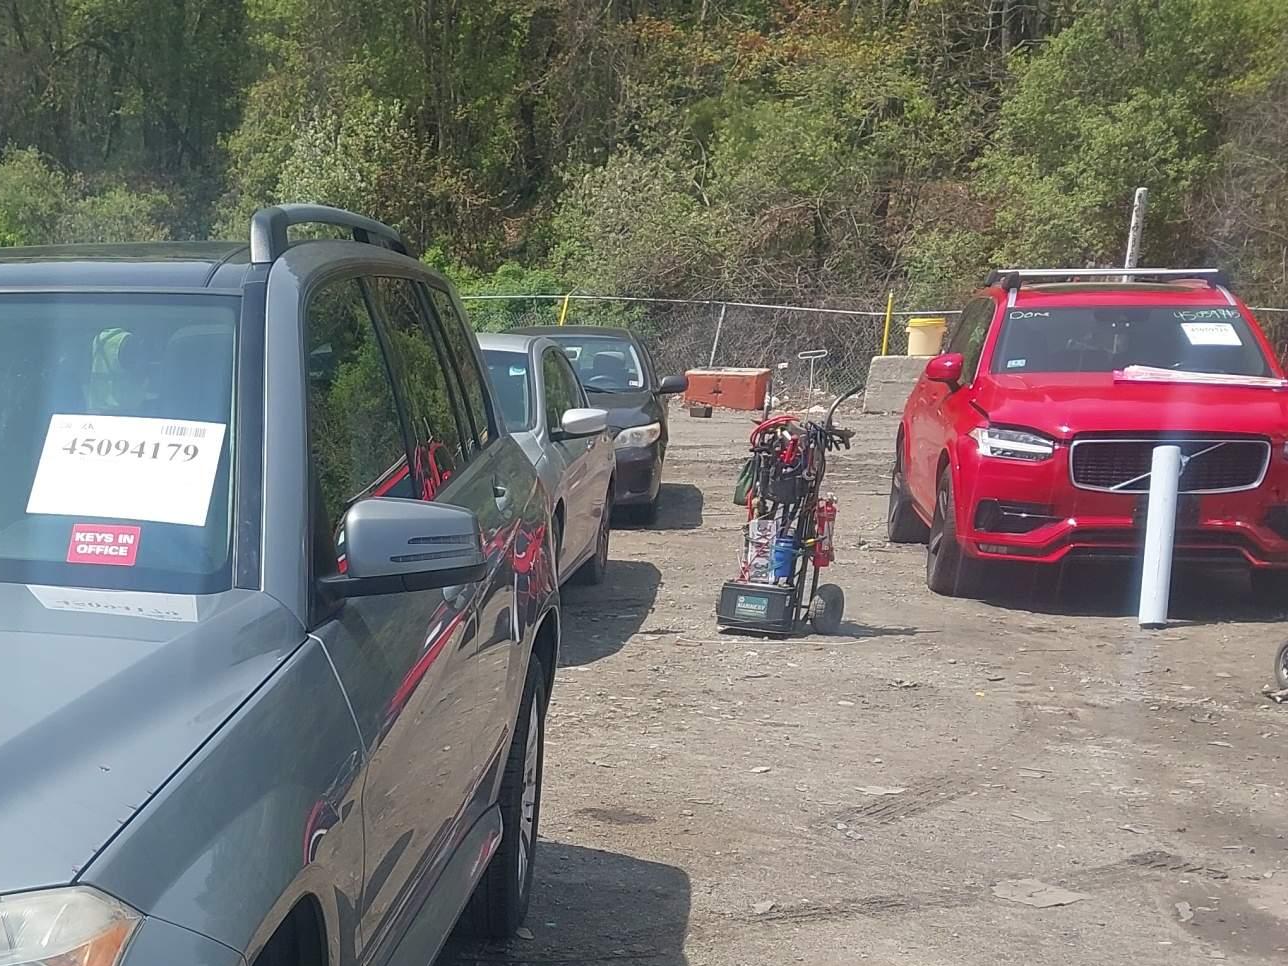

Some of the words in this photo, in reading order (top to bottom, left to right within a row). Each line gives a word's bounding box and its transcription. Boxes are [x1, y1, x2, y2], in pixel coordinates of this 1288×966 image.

[61, 437, 200, 463] 45094179
[74, 531, 114, 544] KEYS
[118, 533, 135, 545] IN
[76, 544, 128, 557] OFFICE
